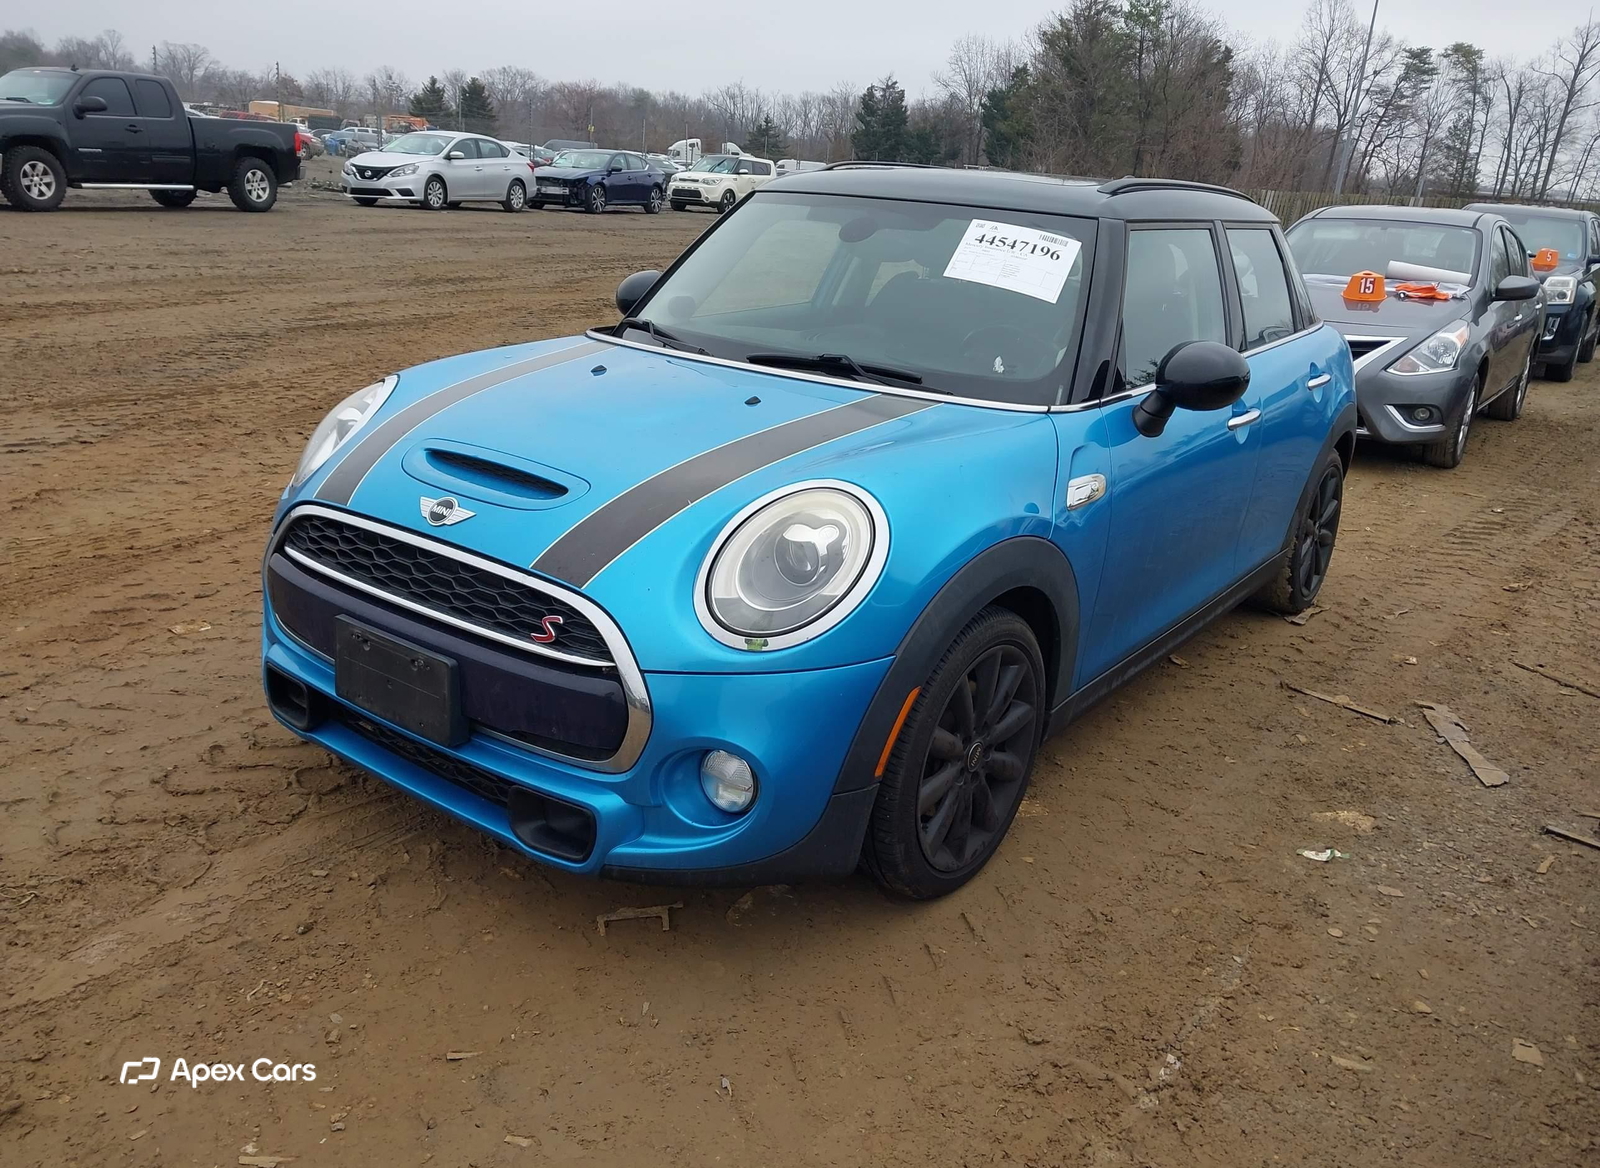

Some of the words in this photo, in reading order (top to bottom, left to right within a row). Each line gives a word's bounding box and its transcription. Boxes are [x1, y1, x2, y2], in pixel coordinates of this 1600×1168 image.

[975, 233, 1062, 261] 44547196
[1546, 251, 1553, 262] 5
[1359, 277, 1375, 294] 15
[432, 504, 452, 517] MINI
[530, 615, 563, 643] S
[970, 747, 982, 767] MINI
